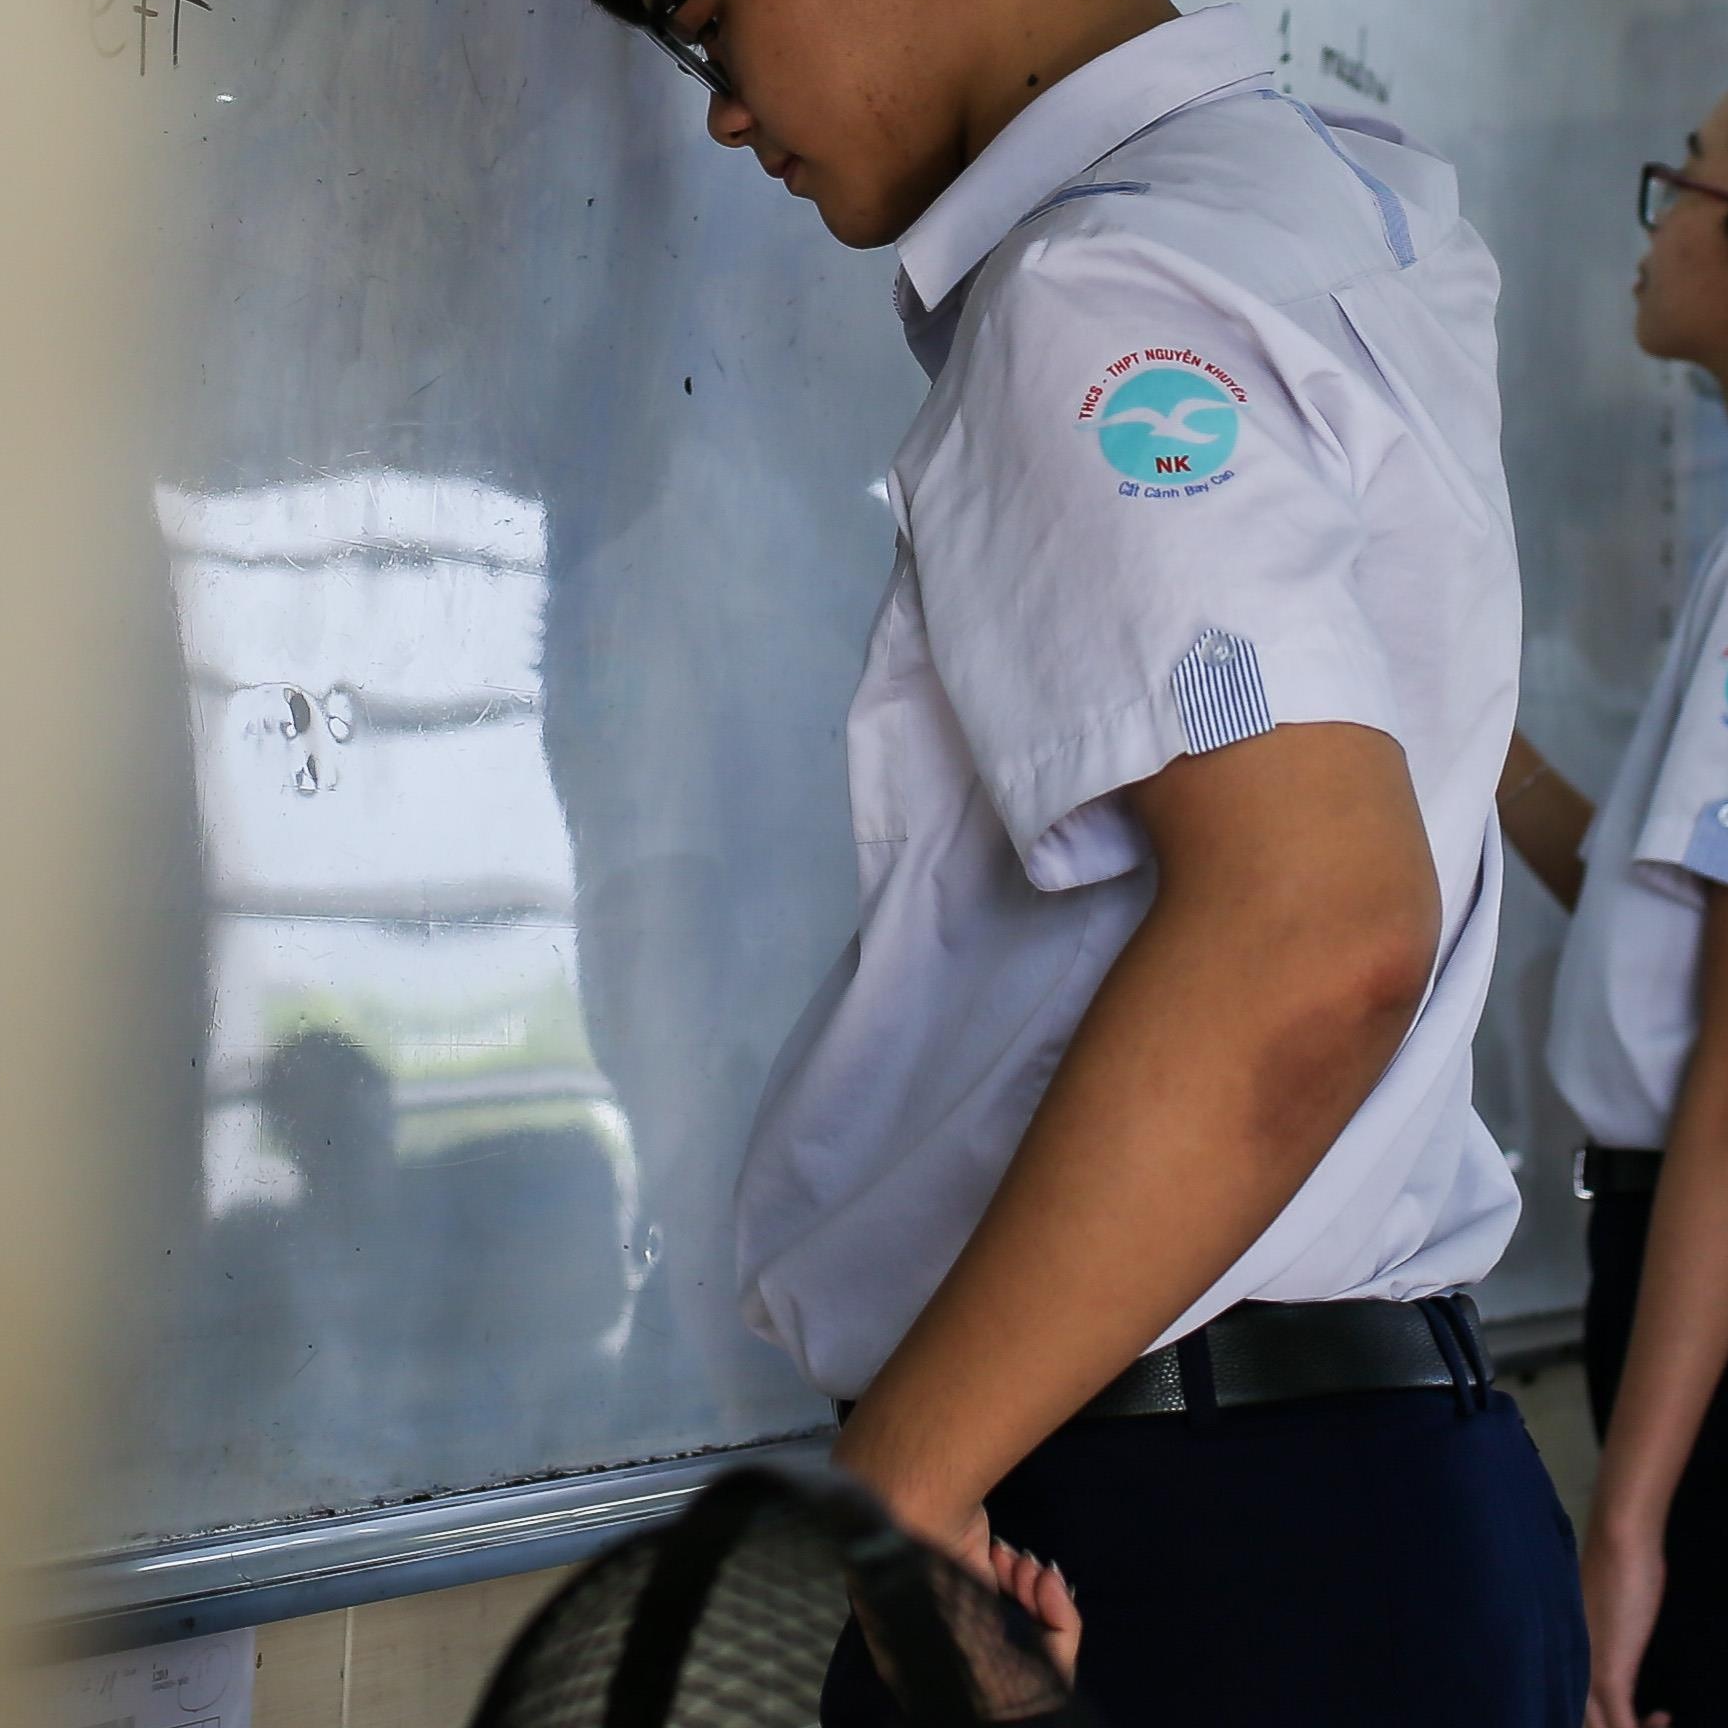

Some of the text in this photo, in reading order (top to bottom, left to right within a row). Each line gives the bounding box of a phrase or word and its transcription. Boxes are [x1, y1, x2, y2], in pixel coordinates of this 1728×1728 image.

[1078, 385, 1104, 420] THCS
[1105, 351, 1141, 379] THPT
[1155, 454, 1192, 474] NK
